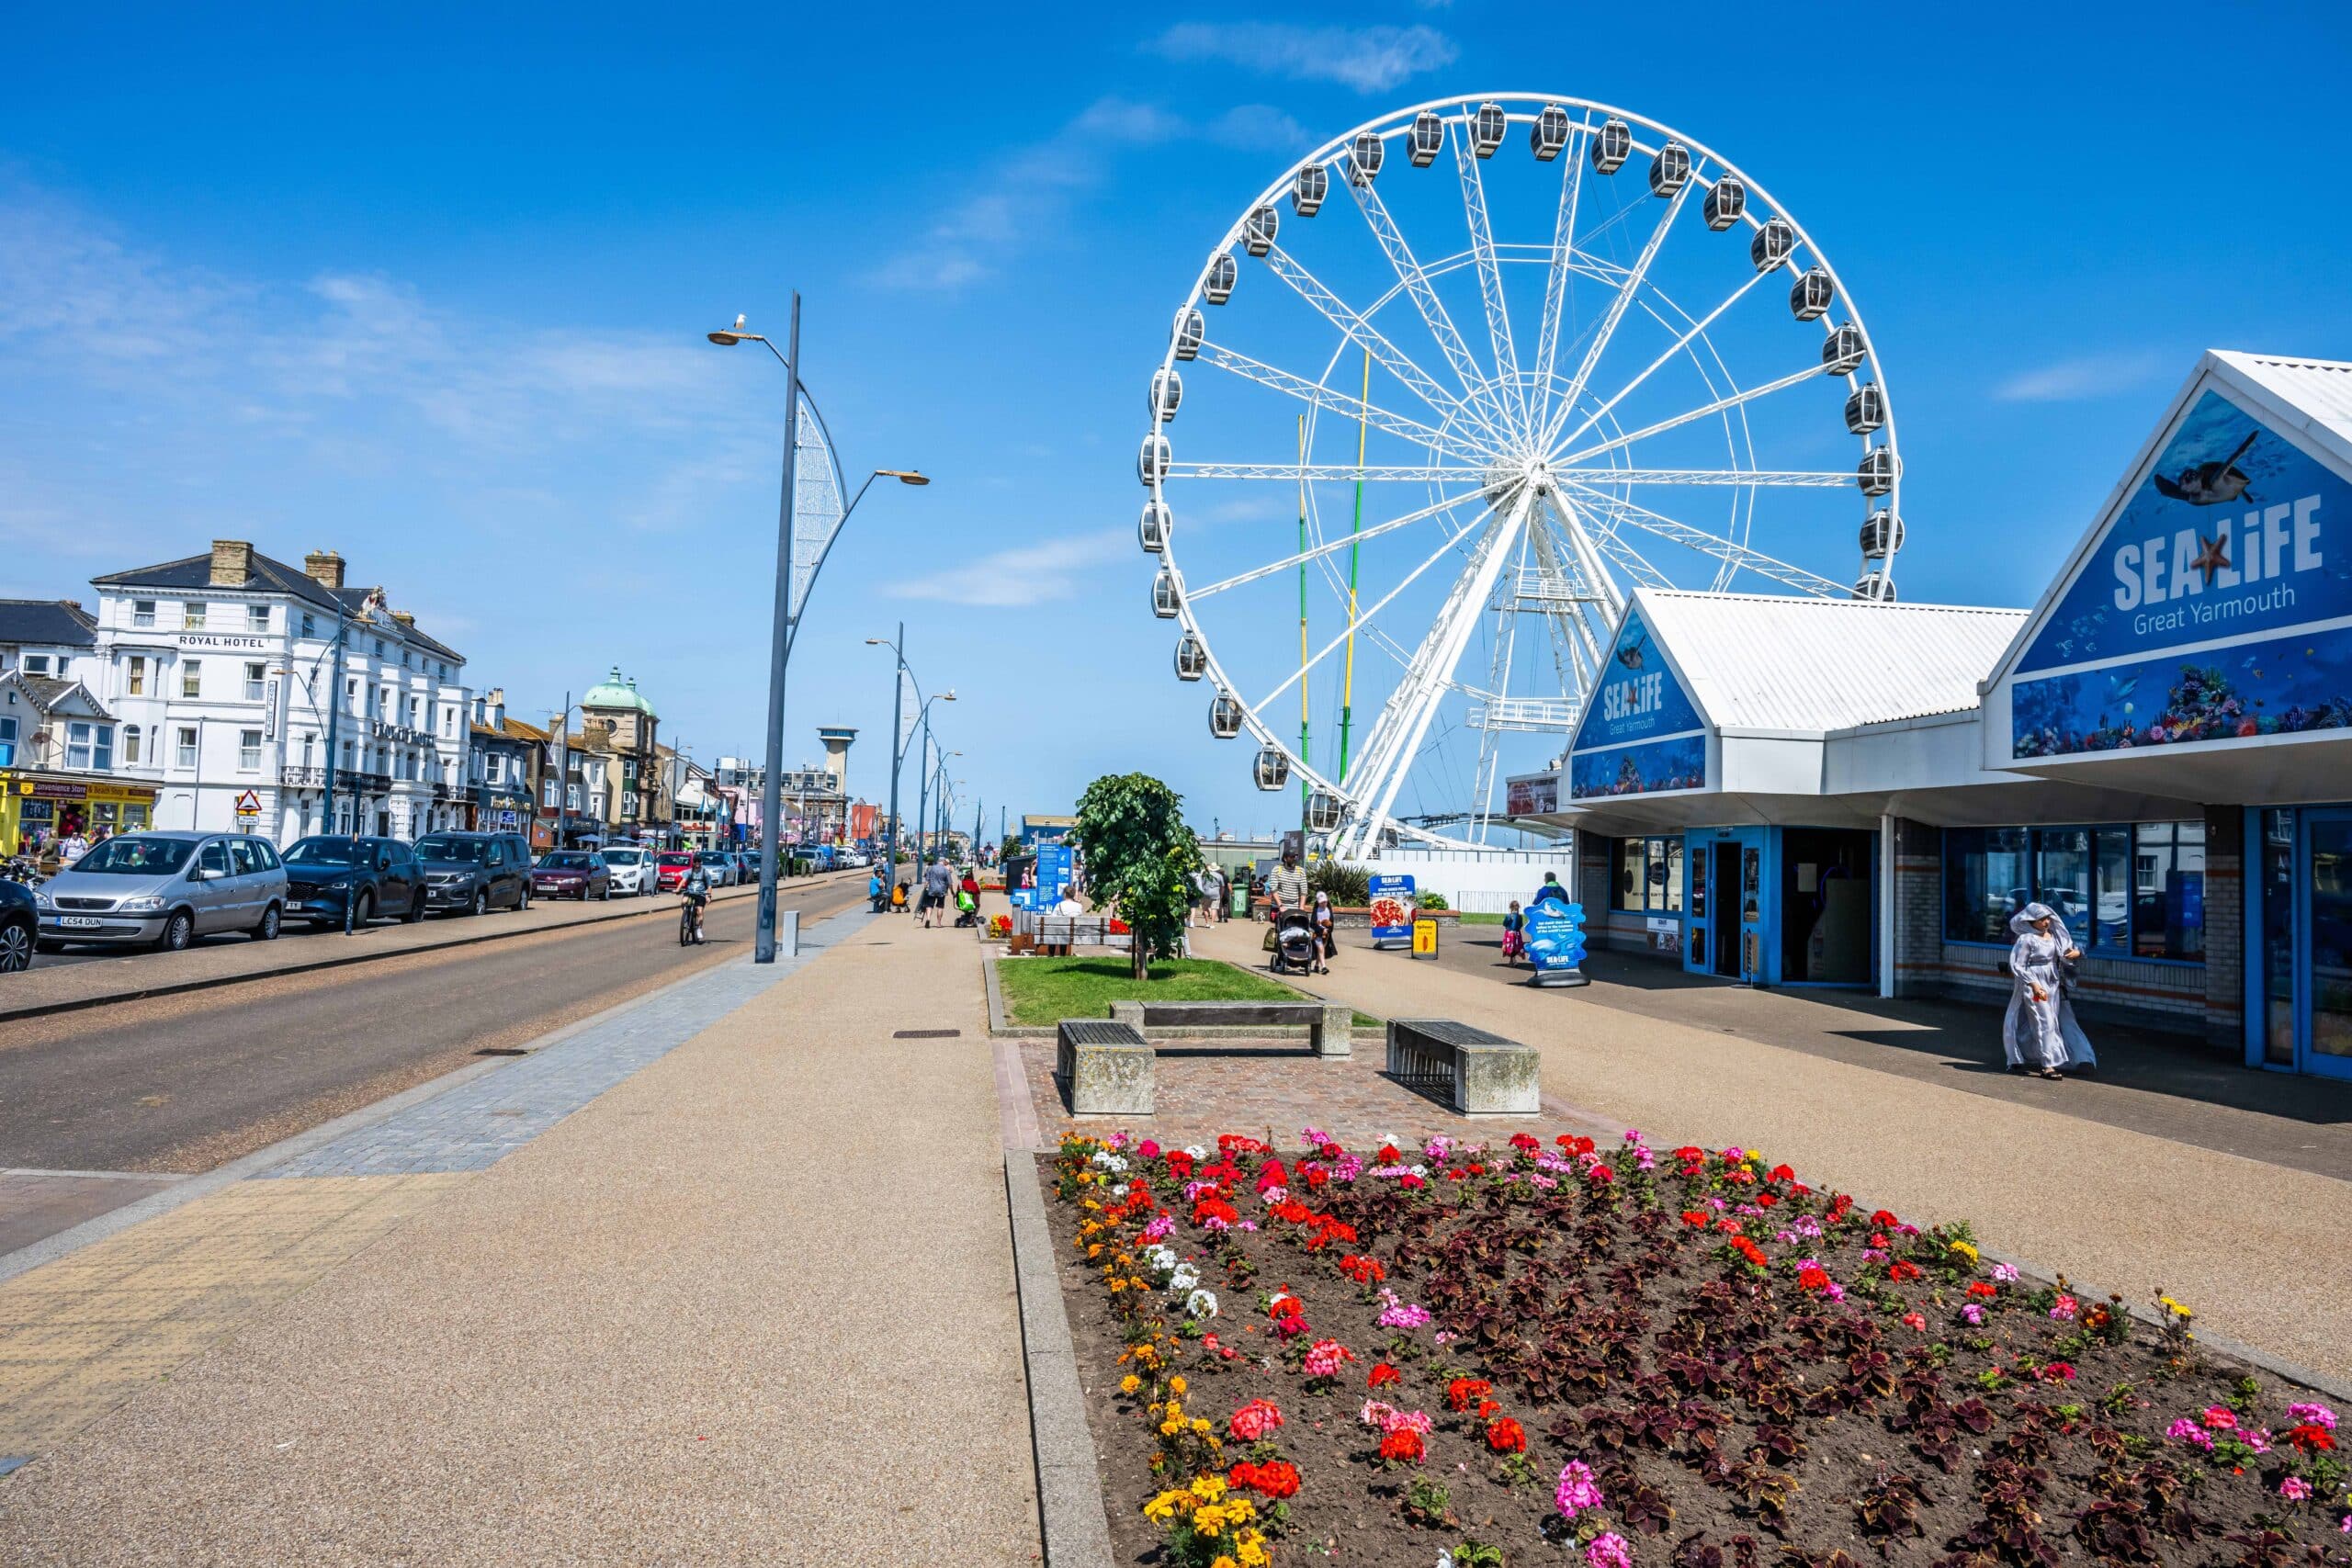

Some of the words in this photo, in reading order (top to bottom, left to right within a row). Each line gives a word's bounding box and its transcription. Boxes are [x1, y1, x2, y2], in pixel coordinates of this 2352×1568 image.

[2114, 528, 2204, 612] SEA
[2134, 606, 2186, 636] Great
[2190, 582, 2295, 625] Yarmouth
[179, 636, 220, 646] ROYAL
[224, 637, 265, 648] HOTEL
[1603, 681, 1631, 722] SEA
[1609, 722, 1625, 736] Great
[1626, 716, 1656, 733] Yarmouth
[34, 784, 73, 793] Convenience
[72, 785, 86, 795] Store
[62, 917, 83, 925] LC54
[85, 918, 101, 926] DUN
